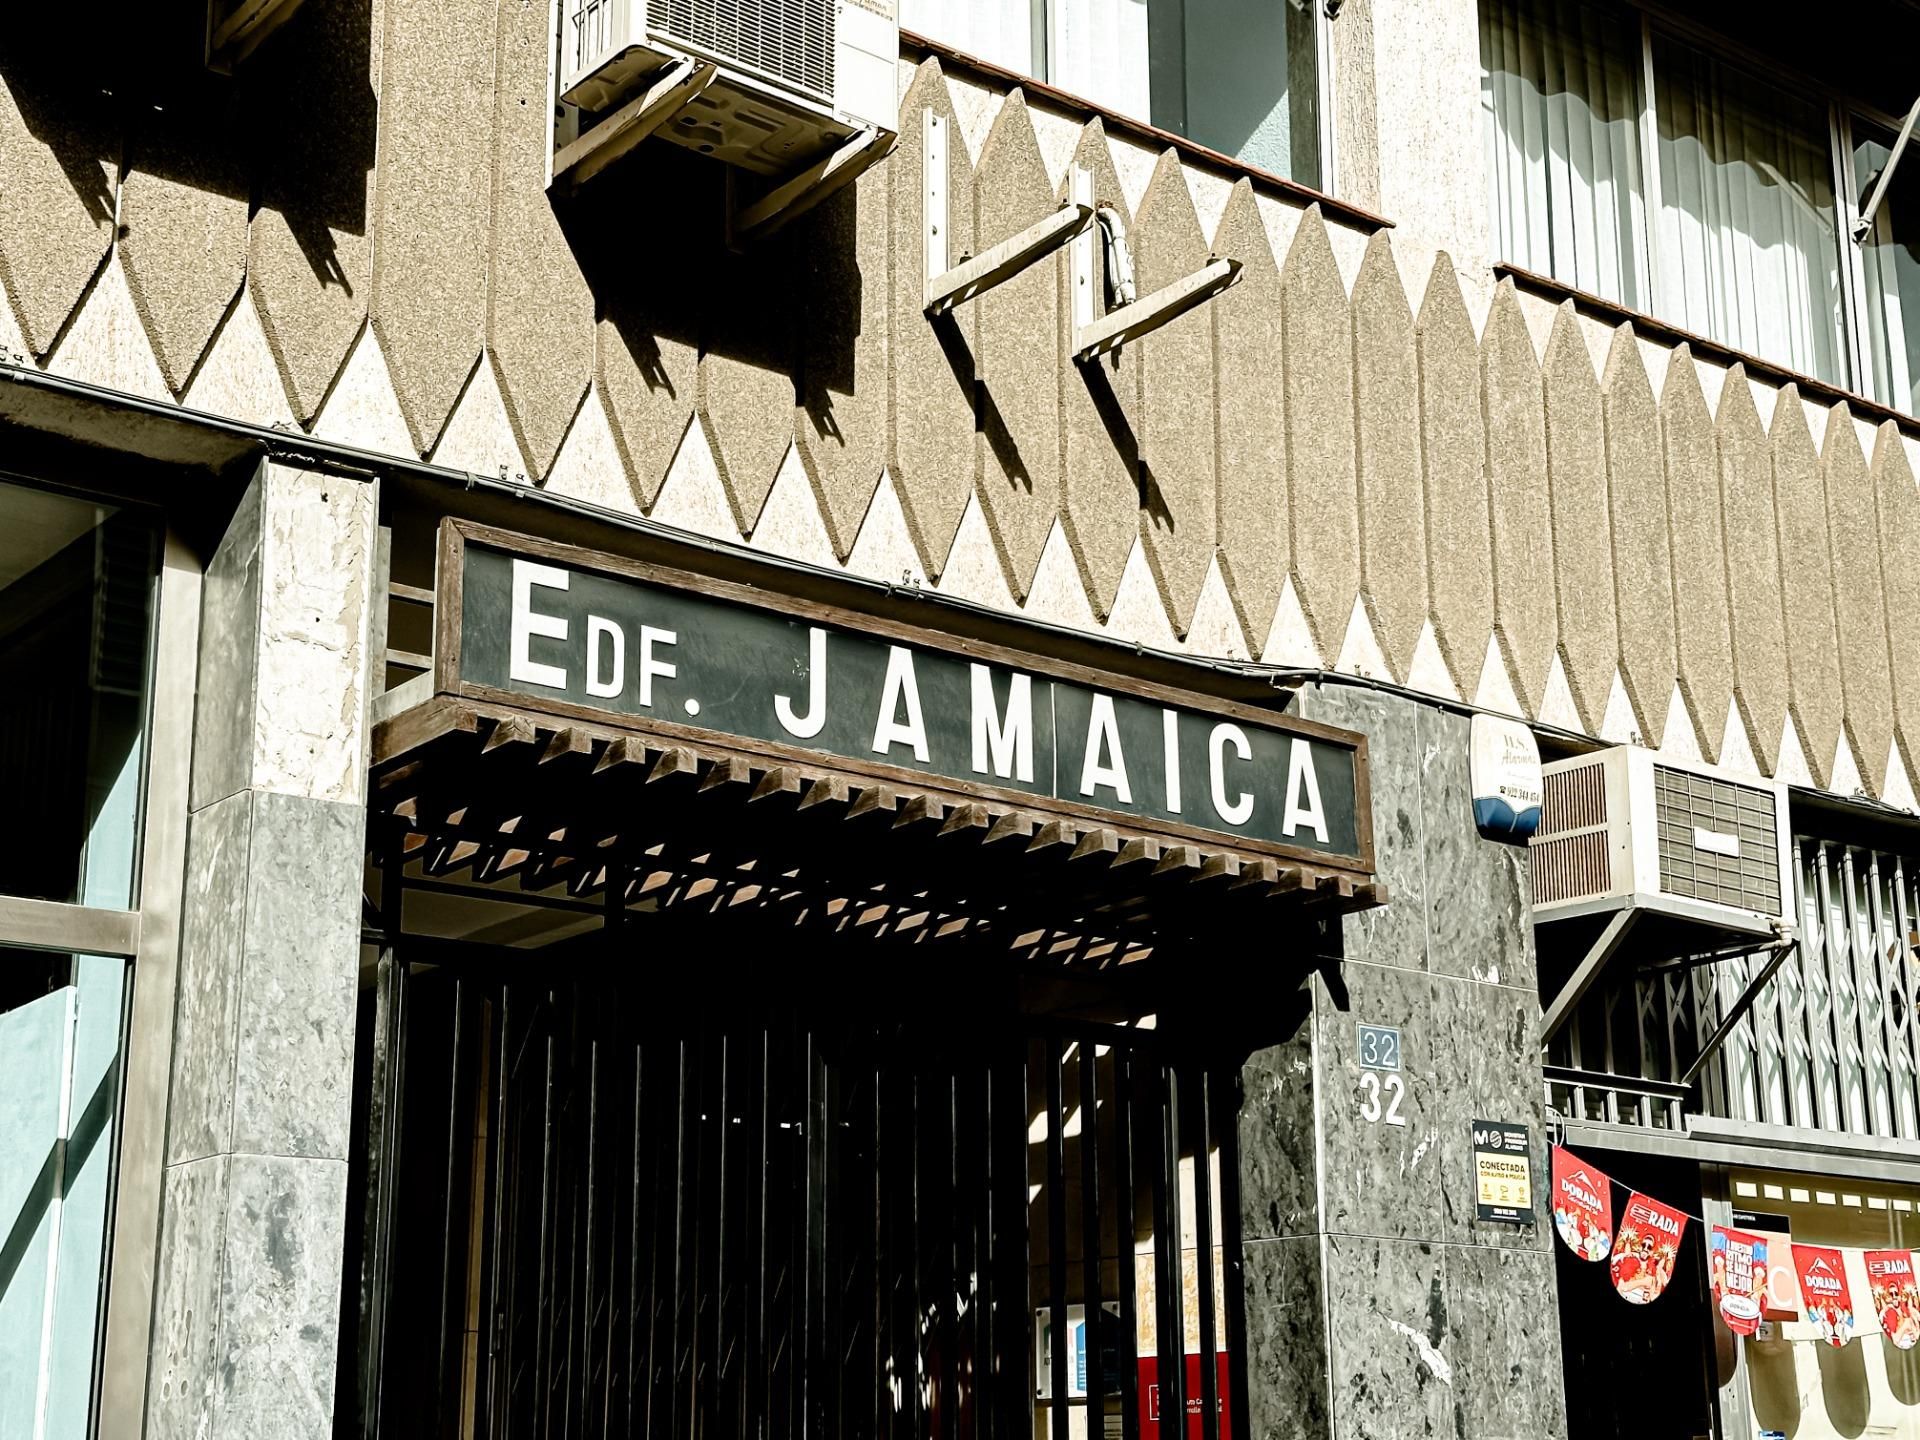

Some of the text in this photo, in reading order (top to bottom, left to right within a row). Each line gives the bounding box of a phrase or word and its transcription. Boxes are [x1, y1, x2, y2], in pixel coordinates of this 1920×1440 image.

[509, 558, 1330, 843] EDF. JAMAICA
[1364, 1031, 1396, 1067] 32
[1360, 1072, 1406, 1126] 32
[1479, 1160, 1525, 1173] CONECTADA
[1560, 1177, 1604, 1213] DORADA
[1726, 1250, 1753, 1265] RITMO
[1804, 1274, 1843, 1291] DORADA
